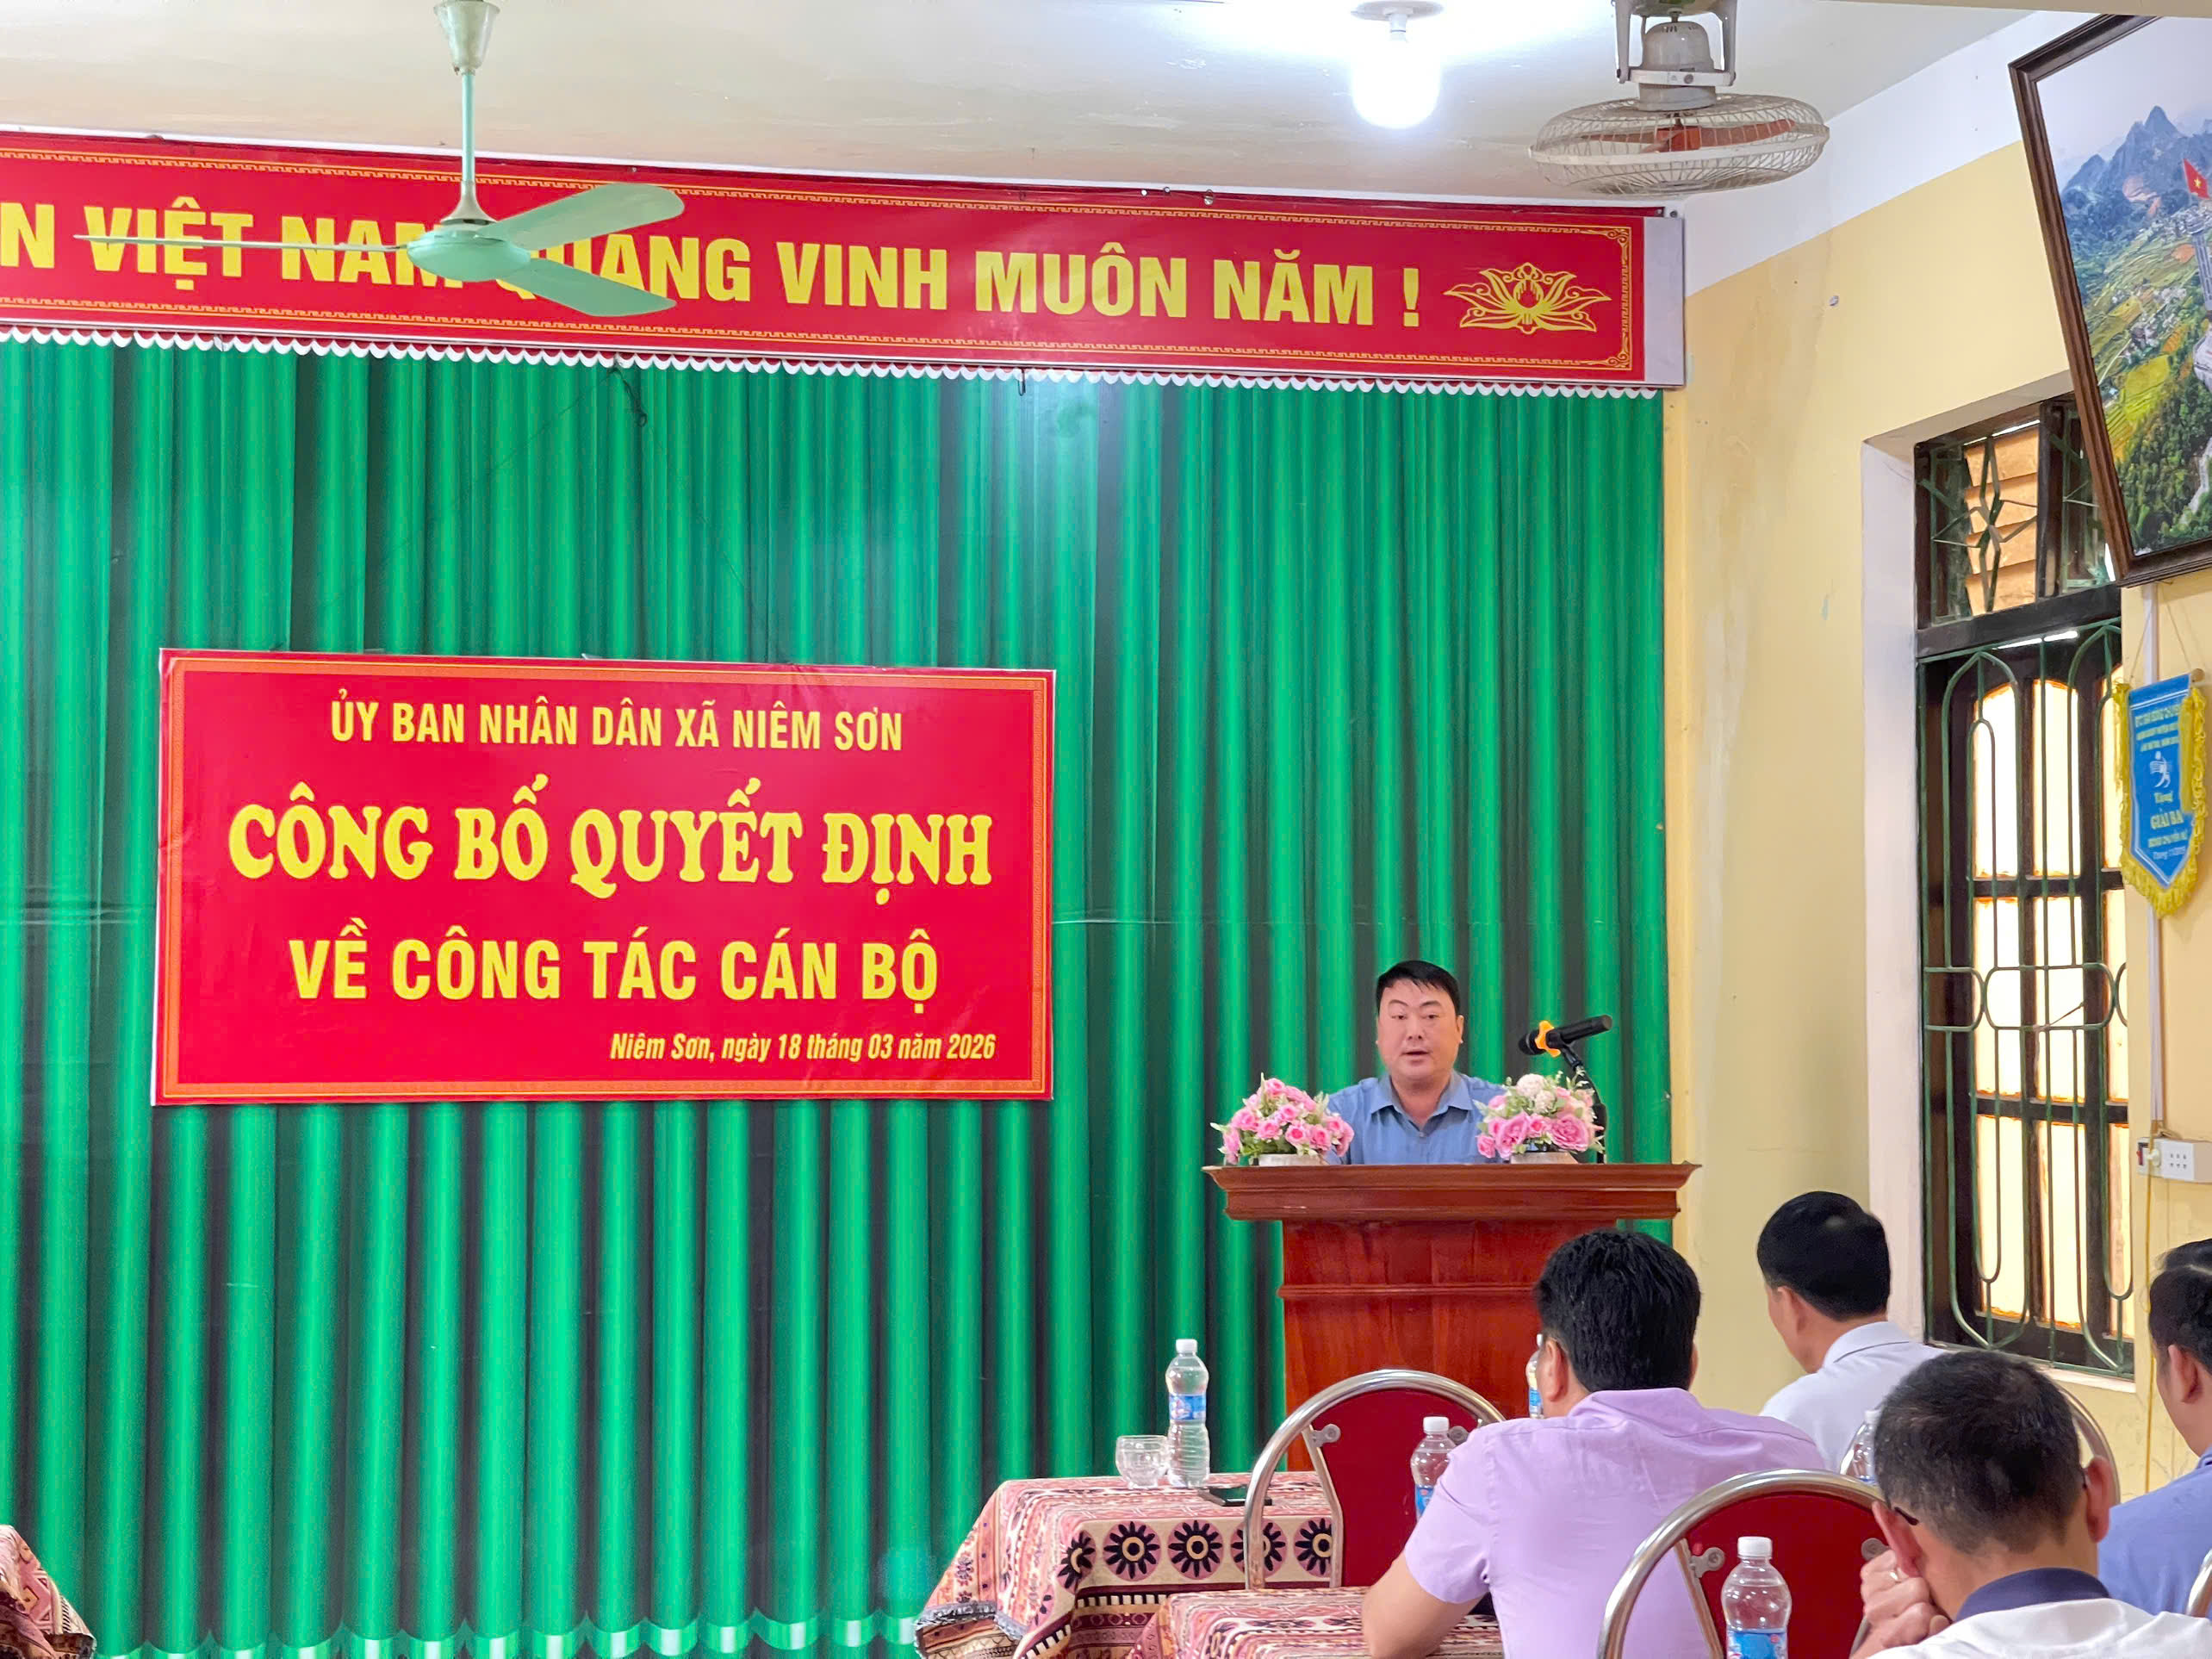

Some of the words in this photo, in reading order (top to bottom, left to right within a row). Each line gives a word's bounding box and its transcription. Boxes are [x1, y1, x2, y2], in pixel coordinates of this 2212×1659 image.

[84, 196, 253, 290] VIỆT
[777, 242, 947, 309] VINH
[976, 242, 1186, 317] MUÔN
[1214, 247, 1373, 326] NĂM
[1403, 269, 1420, 327] !
[331, 688, 379, 742] ỦY
[393, 703, 464, 743] BAN
[480, 696, 577, 745] NHÂN
[593, 698, 662, 747] DÂN
[675, 700, 719, 748] XÃ
[733, 701, 821, 749] NIÊM
[835, 705, 902, 751] SƠN
[228, 782, 433, 880] CÔNG
[454, 774, 549, 881] BỐ
[570, 777, 804, 899] QUYẾT
[821, 812, 992, 905] ĐỊNH
[289, 917, 367, 999] VỀ
[392, 926, 560, 1000] CÔNG
[583, 927, 697, 1000] TÁC
[721, 928, 836, 1001] CÁN
[862, 929, 938, 1014] BỘ
[609, 1033, 665, 1059] Niêm
[671, 1033, 715, 1062] Sơn,
[721, 1033, 772, 1063] ngày
[778, 1034, 802, 1059] 18
[806, 1034, 863, 1062] tháng
[867, 1034, 893, 1059] 03
[898, 1034, 942, 1059] năm
[946, 1034, 997, 1060] 2026
